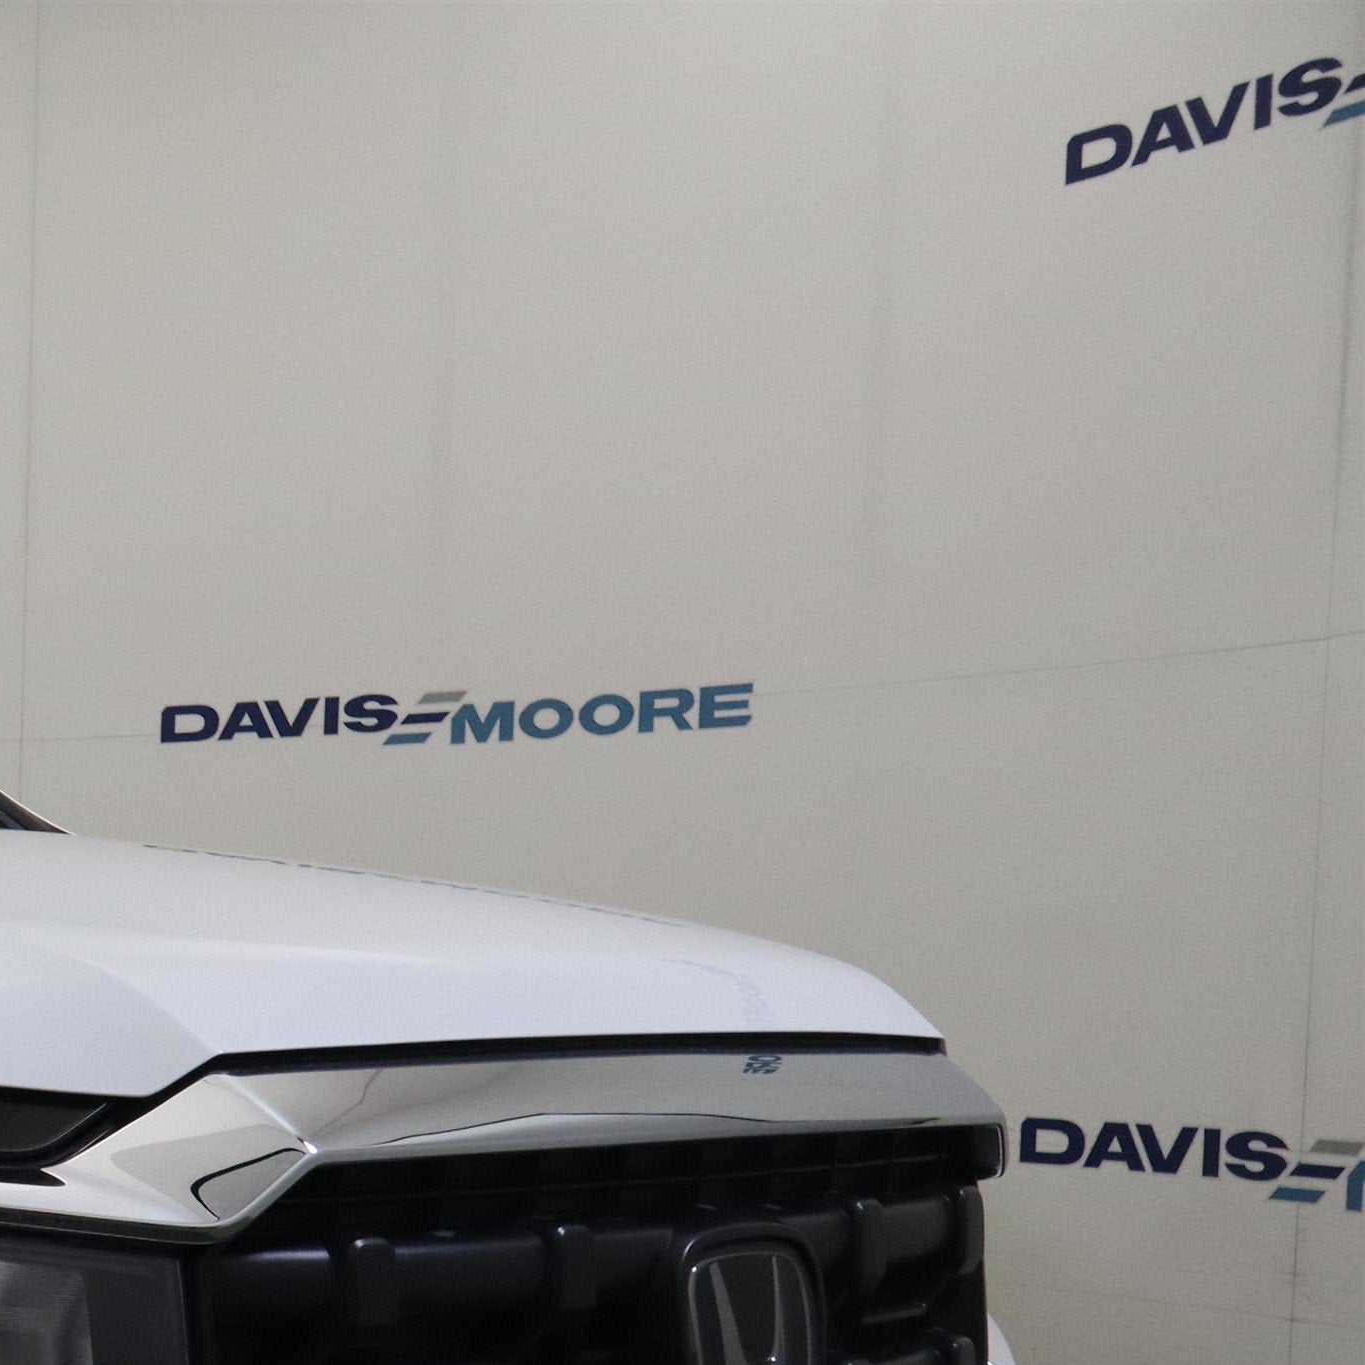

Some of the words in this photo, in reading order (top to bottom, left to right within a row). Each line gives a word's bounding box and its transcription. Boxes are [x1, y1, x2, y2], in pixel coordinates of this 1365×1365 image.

[1065, 57, 1343, 186] DAVIS
[161, 694, 398, 744] DAVIS
[450, 682, 754, 746] MOORE
[1020, 1117, 1290, 1182] DAVIS
